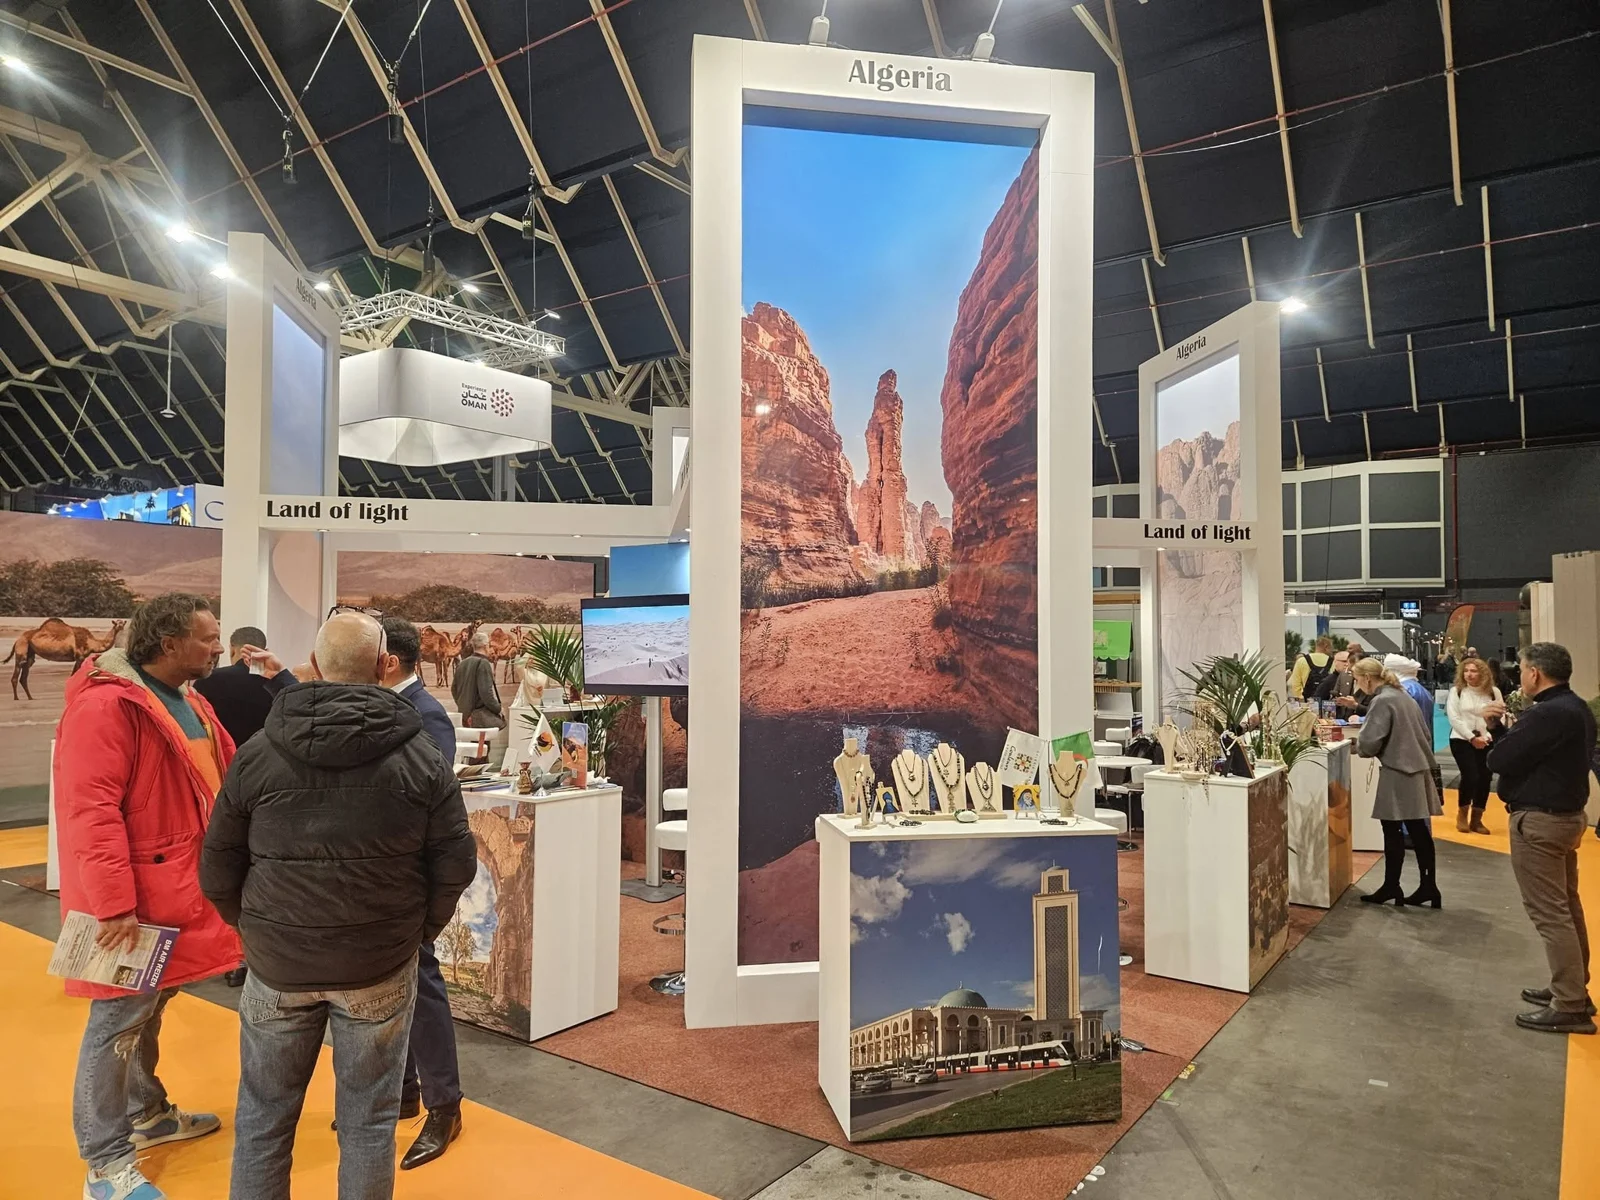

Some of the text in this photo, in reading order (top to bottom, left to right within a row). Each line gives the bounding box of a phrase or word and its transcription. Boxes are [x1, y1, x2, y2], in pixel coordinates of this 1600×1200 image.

[848, 59, 953, 92] Algeria
[296, 277, 317, 311] Algeria
[1176, 335, 1207, 361] Algeria
[461, 382, 487, 393] Experience
[461, 398, 487, 411] OMAN
[266, 500, 409, 524] Land of light
[1144, 523, 1252, 544] Land of light
[158, 950, 168, 963] AIR
[149, 963, 164, 988] REIZEN
